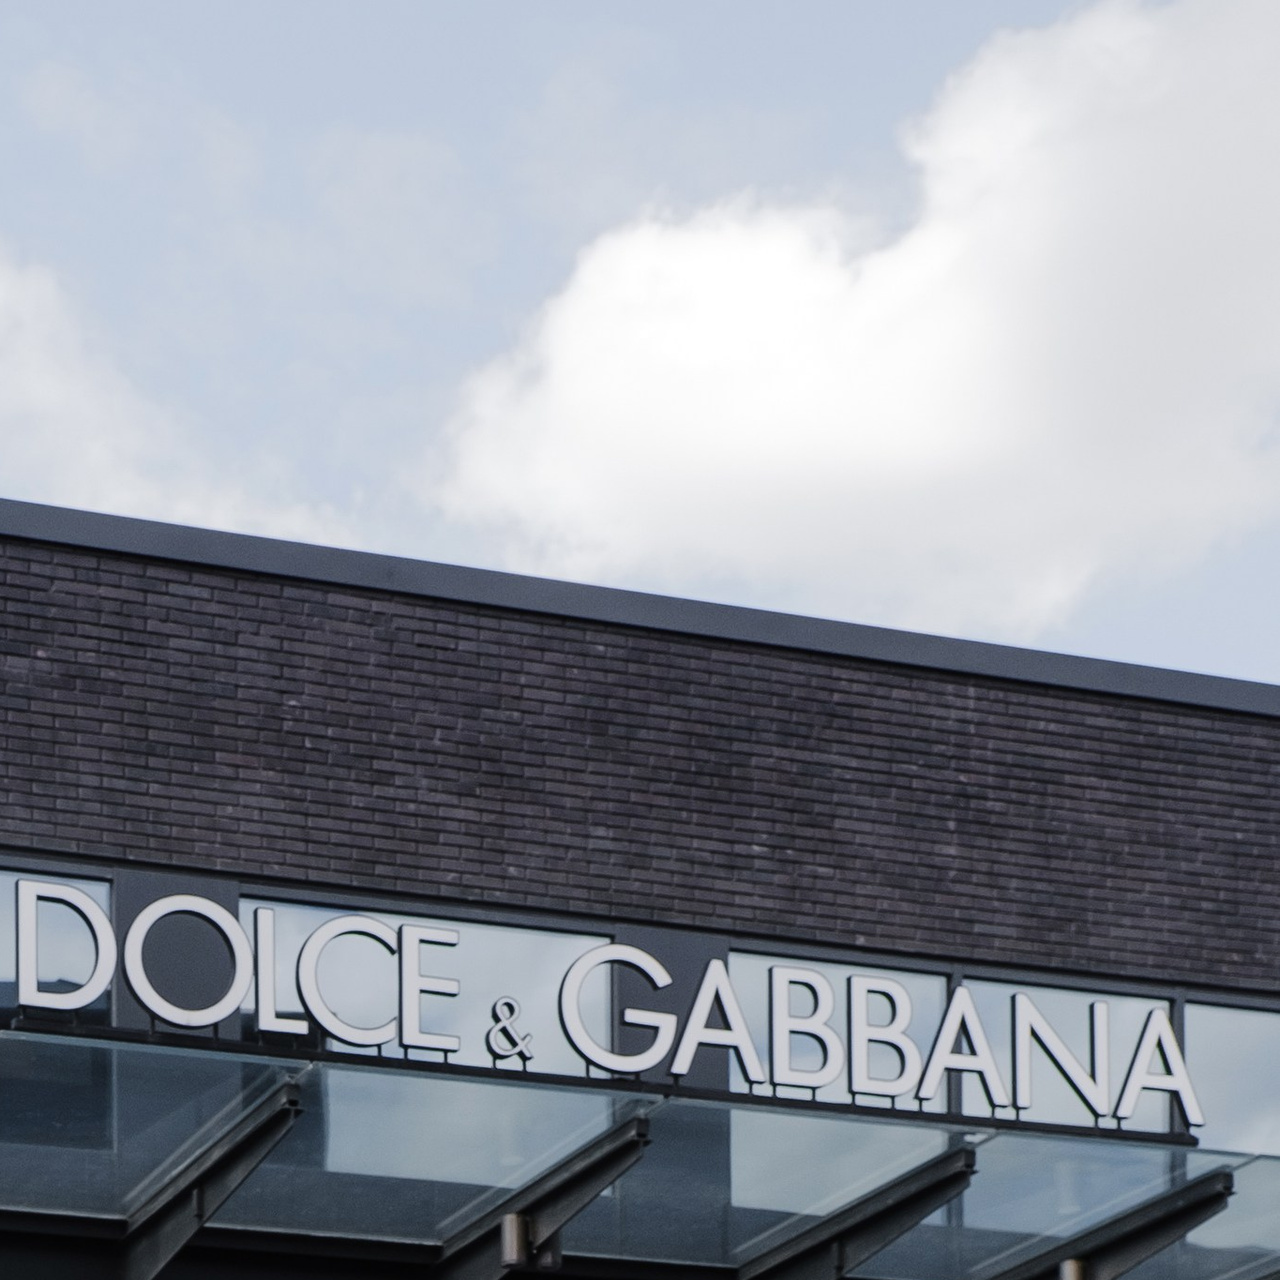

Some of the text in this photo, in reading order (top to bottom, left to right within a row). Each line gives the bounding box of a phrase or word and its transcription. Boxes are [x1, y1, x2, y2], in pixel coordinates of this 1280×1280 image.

[16, 878, 1206, 1128] DOLCE & GABBANA
